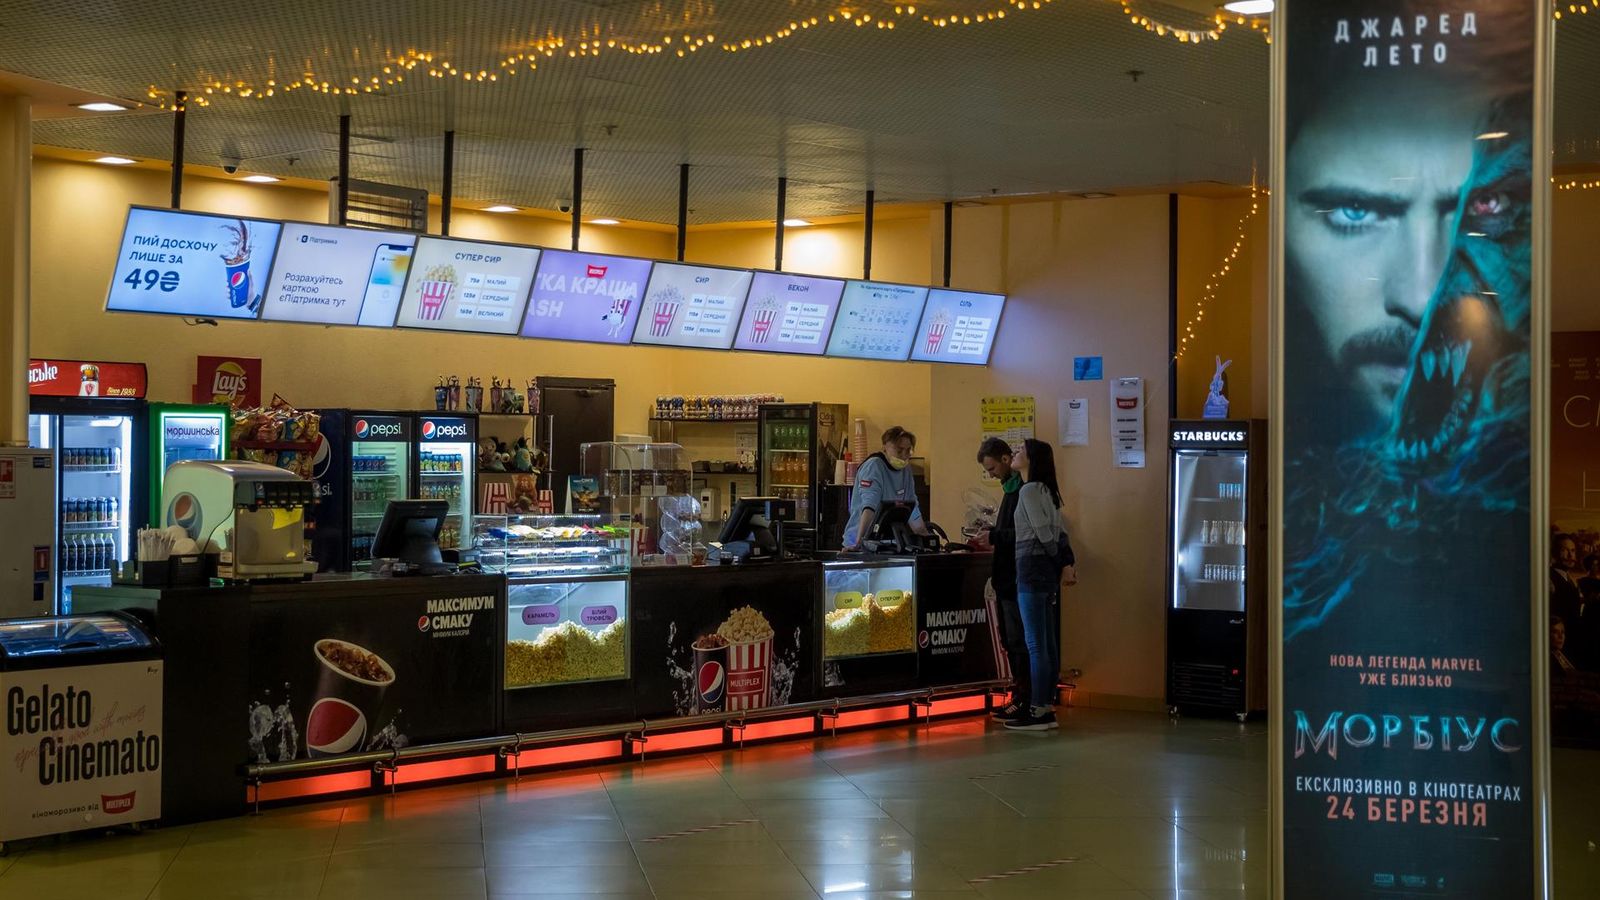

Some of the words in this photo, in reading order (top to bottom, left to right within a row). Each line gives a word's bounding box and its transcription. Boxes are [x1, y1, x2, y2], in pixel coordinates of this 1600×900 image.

[1335, 12, 1477, 43] ДЖАРЕД
[1363, 42, 1447, 67] ЛЕТО
[133, 235, 159, 247] ПИЙ
[161, 239, 218, 251] ДОСХОЧУ
[129, 251, 166, 263] ЛИШЕ
[168, 254, 183, 264] ЗА
[455, 252, 483, 262] СУПЕР
[484, 255, 502, 264] СИР
[124, 268, 180, 292] 49₴
[284, 272, 344, 286] Розрахуйтесь
[695, 276, 710, 284] СИР
[281, 285, 319, 295] карткою
[787, 284, 810, 292] БЕКОН
[279, 294, 330, 305] єПідтримка
[333, 298, 346, 308] тут
[212, 371, 248, 400] Lay's
[166, 426, 220, 437] моршинська
[370, 422, 401, 438] pepsi
[437, 423, 467, 438] pepsi
[1173, 431, 1244, 441] STARBUCKS
[427, 596, 494, 613] МАКСИМУМ
[432, 613, 474, 630] СМАКУ
[926, 608, 986, 627] МАКСИМУМ
[931, 628, 967, 646] СМАКУ
[1330, 654, 1364, 668] НОВА
[1368, 655, 1427, 671] ЛЕГЕНДА
[1432, 657, 1483, 672] MARVEL
[730, 678, 760, 687] MULTIPLEX
[1359, 673, 1387, 686] УЖЕ
[1391, 674, 1453, 688] БЛИЗЬКО
[7, 684, 91, 736] Gelato
[1293, 710, 1521, 760] МОРБІУС
[39, 730, 160, 785] Cinemato
[1296, 776, 1401, 795] ЕКСКЛЮЗИВНО
[1409, 781, 1417, 795] В
[1424, 782, 1521, 801] КІНОТЕАТРАХ
[1326, 796, 1356, 820] 24
[1367, 798, 1487, 827] БЕРЕЗНЯ
